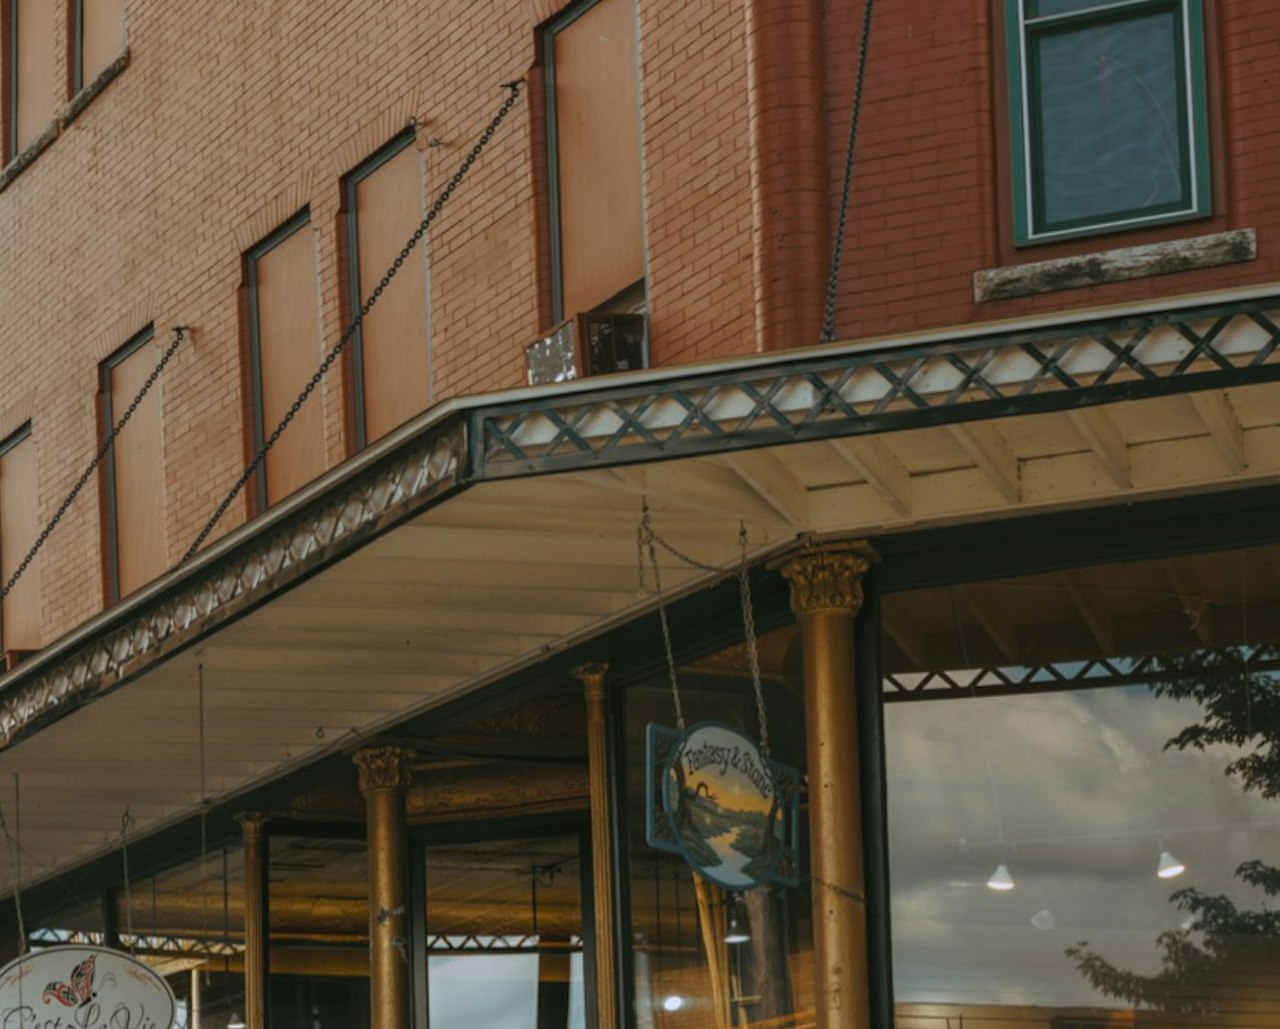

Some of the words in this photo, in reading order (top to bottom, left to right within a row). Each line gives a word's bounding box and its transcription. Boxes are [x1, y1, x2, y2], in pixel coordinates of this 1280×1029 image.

[683, 740, 732, 776] Fantasy
[731, 746, 743, 771] &
[742, 752, 774, 799] Stone
